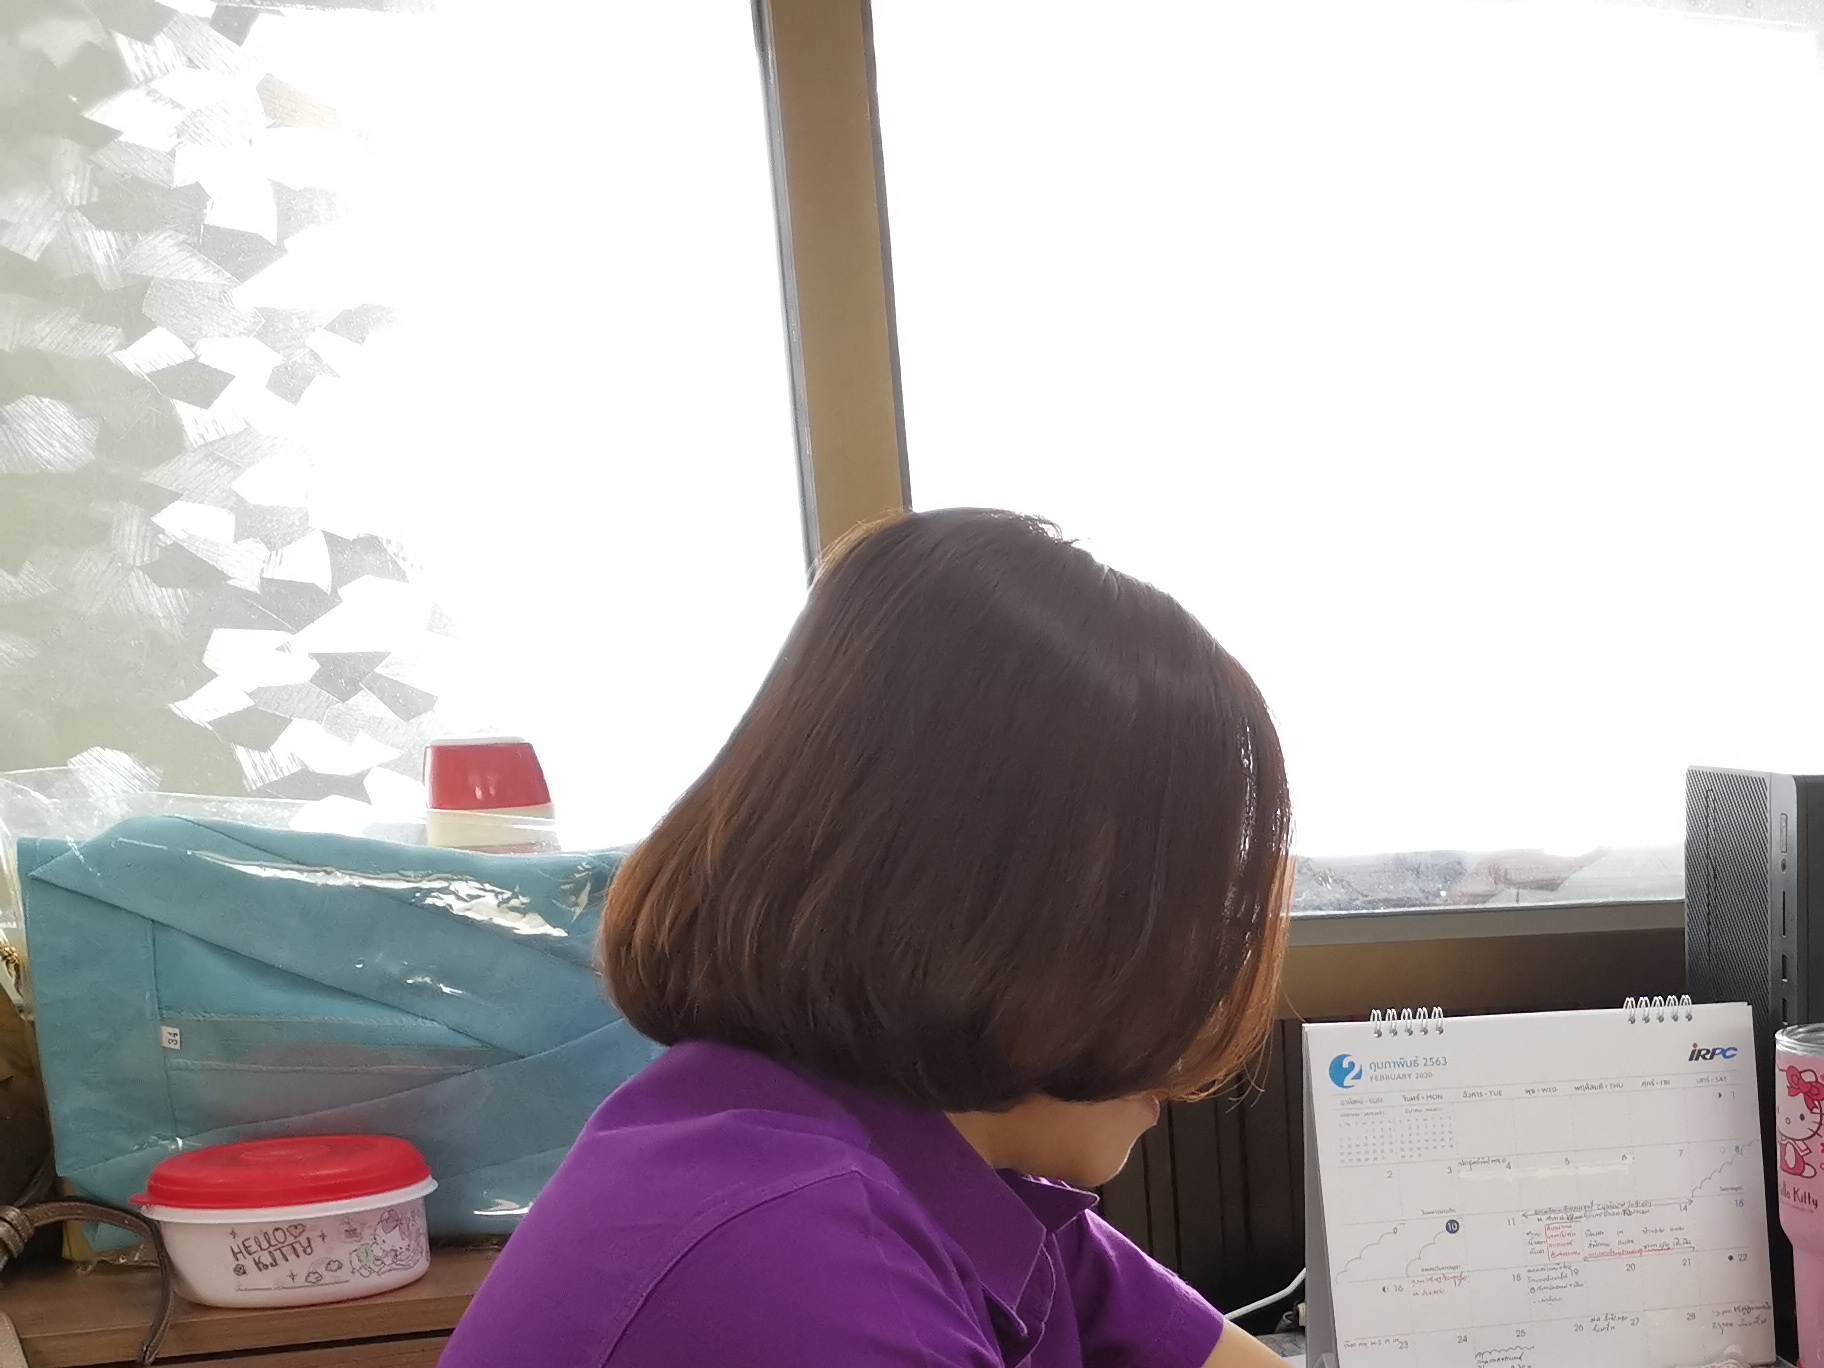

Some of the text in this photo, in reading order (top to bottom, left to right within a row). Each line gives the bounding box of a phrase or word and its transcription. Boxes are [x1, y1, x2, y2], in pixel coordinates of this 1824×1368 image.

[1369, 1055, 1448, 1073] กุมภาพันธ์ 2563
[1369, 1072, 1433, 1082] FEBRUARY 2020
[1793, 1187, 1818, 1209] Kitty
